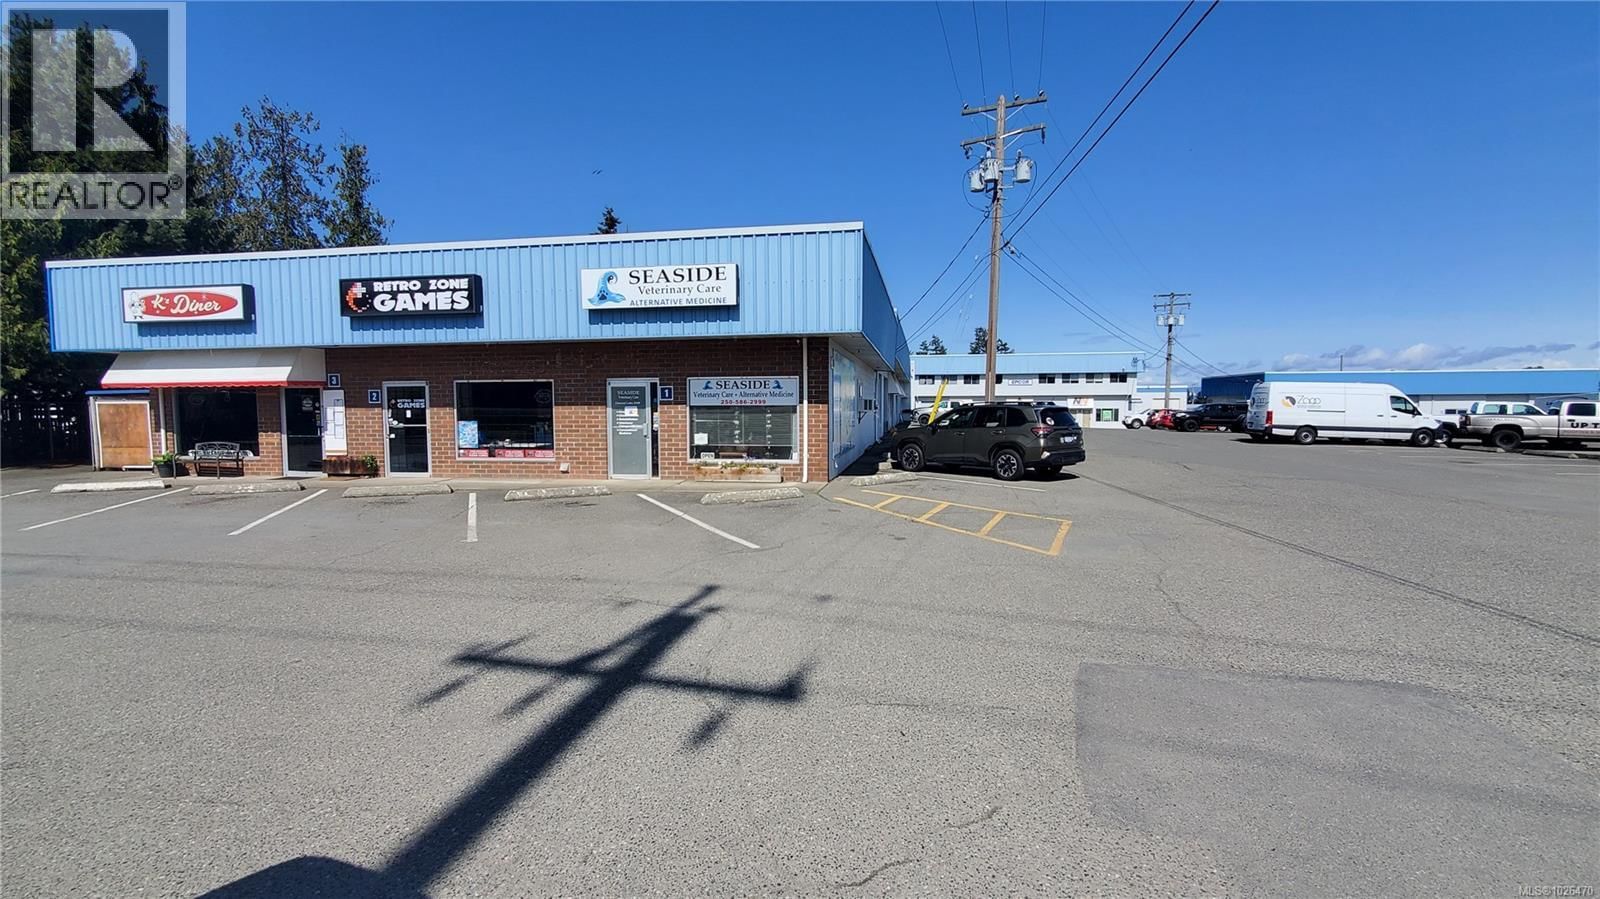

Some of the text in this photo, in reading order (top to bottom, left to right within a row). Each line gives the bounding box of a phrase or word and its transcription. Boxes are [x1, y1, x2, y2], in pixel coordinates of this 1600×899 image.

[629, 266, 727, 285] SEASIDE
[373, 278, 469, 292] RETRO ZONE
[638, 283, 722, 296] Veterinary Care
[170, 294, 222, 314] Diner
[373, 291, 470, 312] GAMES
[629, 297, 727, 307] ALTERNATIVE MEDICINE
[331, 376, 337, 385] 3
[715, 380, 771, 390] SEASIDE
[371, 392, 378, 401] 2
[664, 389, 669, 398] 1
